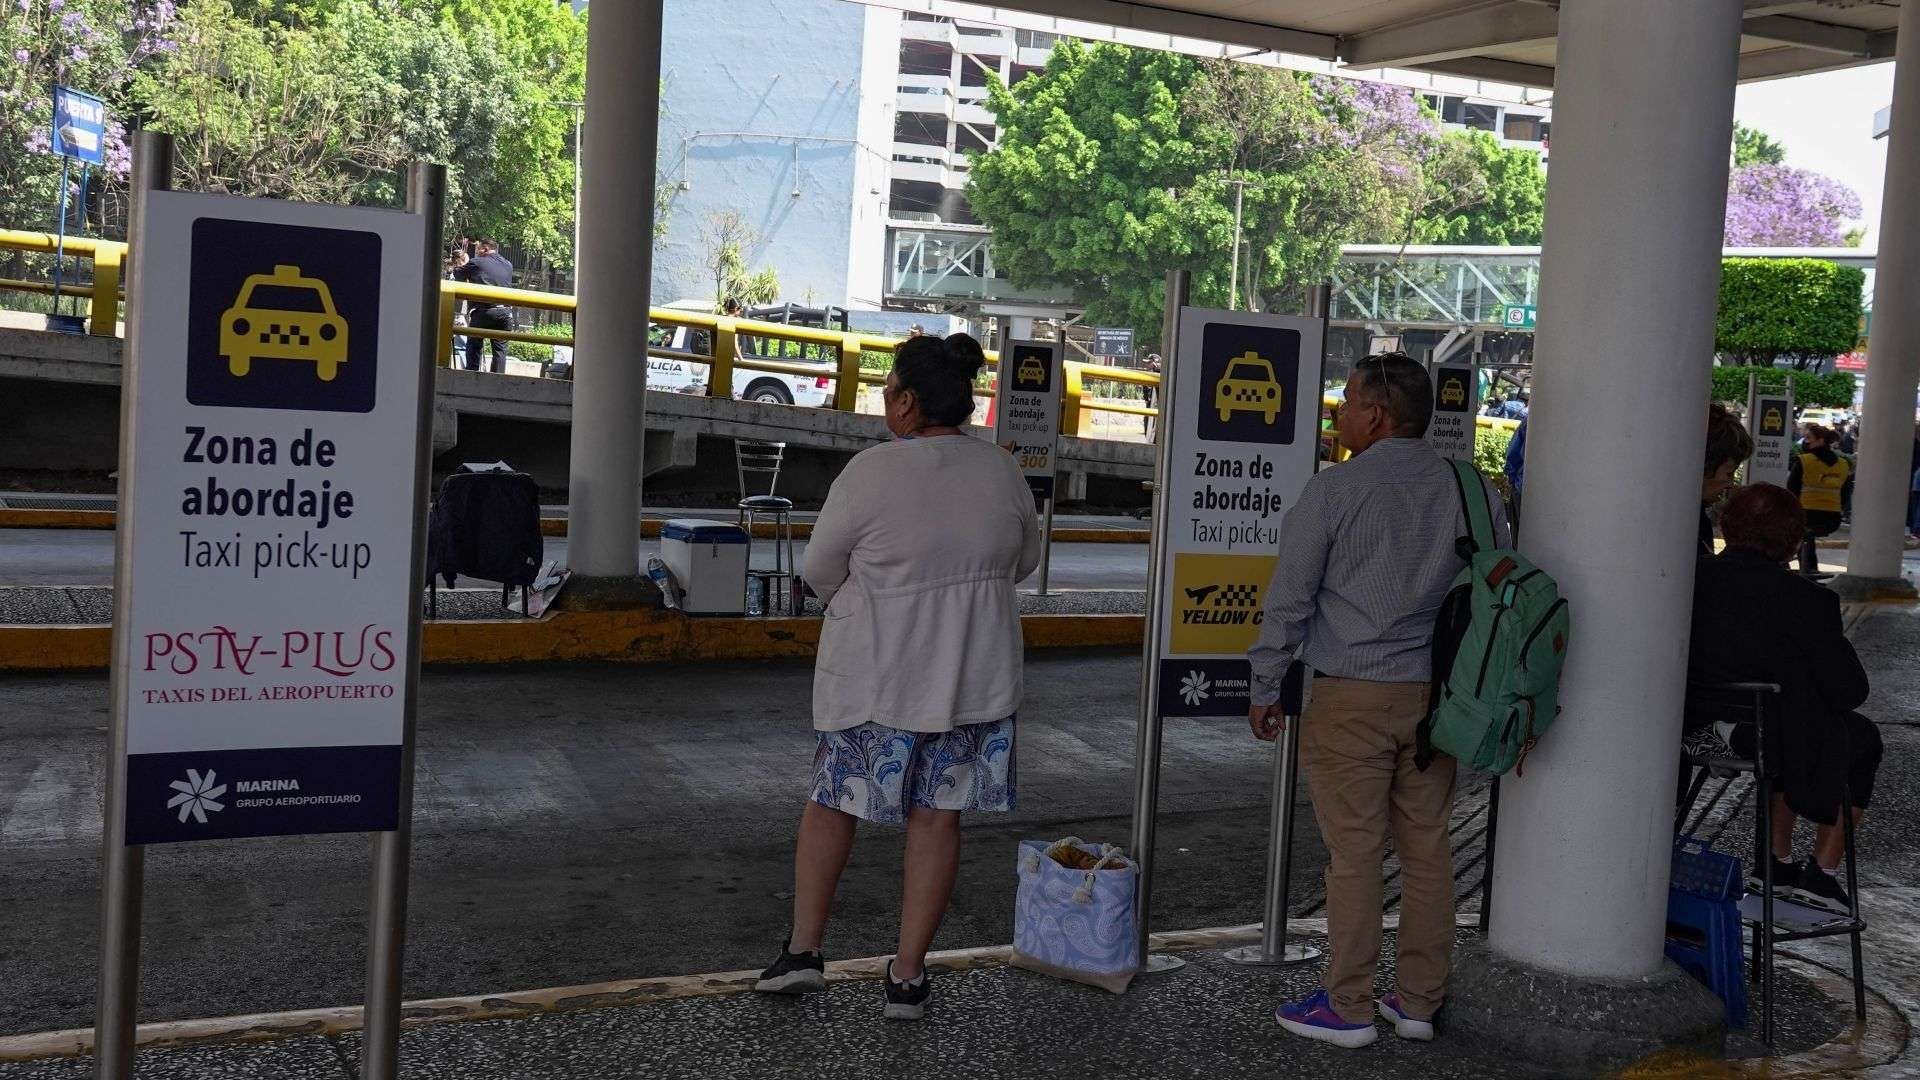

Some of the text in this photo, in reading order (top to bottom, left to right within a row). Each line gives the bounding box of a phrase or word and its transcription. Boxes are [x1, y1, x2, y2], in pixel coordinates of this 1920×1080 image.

[1010, 396, 1042, 407] Zona de
[1009, 409, 1045, 422] abordaje
[1433, 428, 1464, 440] abordaje
[183, 426, 336, 467] Zona de
[1022, 446, 1048, 456] SITIO
[1019, 456, 1047, 469] 300
[1194, 453, 1273, 480] Zona de
[181, 477, 354, 529] abordaje
[1193, 485, 1281, 518] abordaje
[1191, 519, 1278, 550] Taxi pick-u
[179, 530, 371, 579] Taxi pick-up
[1182, 609, 1249, 625] YELLOW
[1215, 680, 1248, 688] MARINA
[143, 685, 394, 704] TAXIS DEL AEROPUERTO
[236, 779, 300, 793] MARINA
[236, 794, 361, 808] GRUPO AEROPORTUARIO
